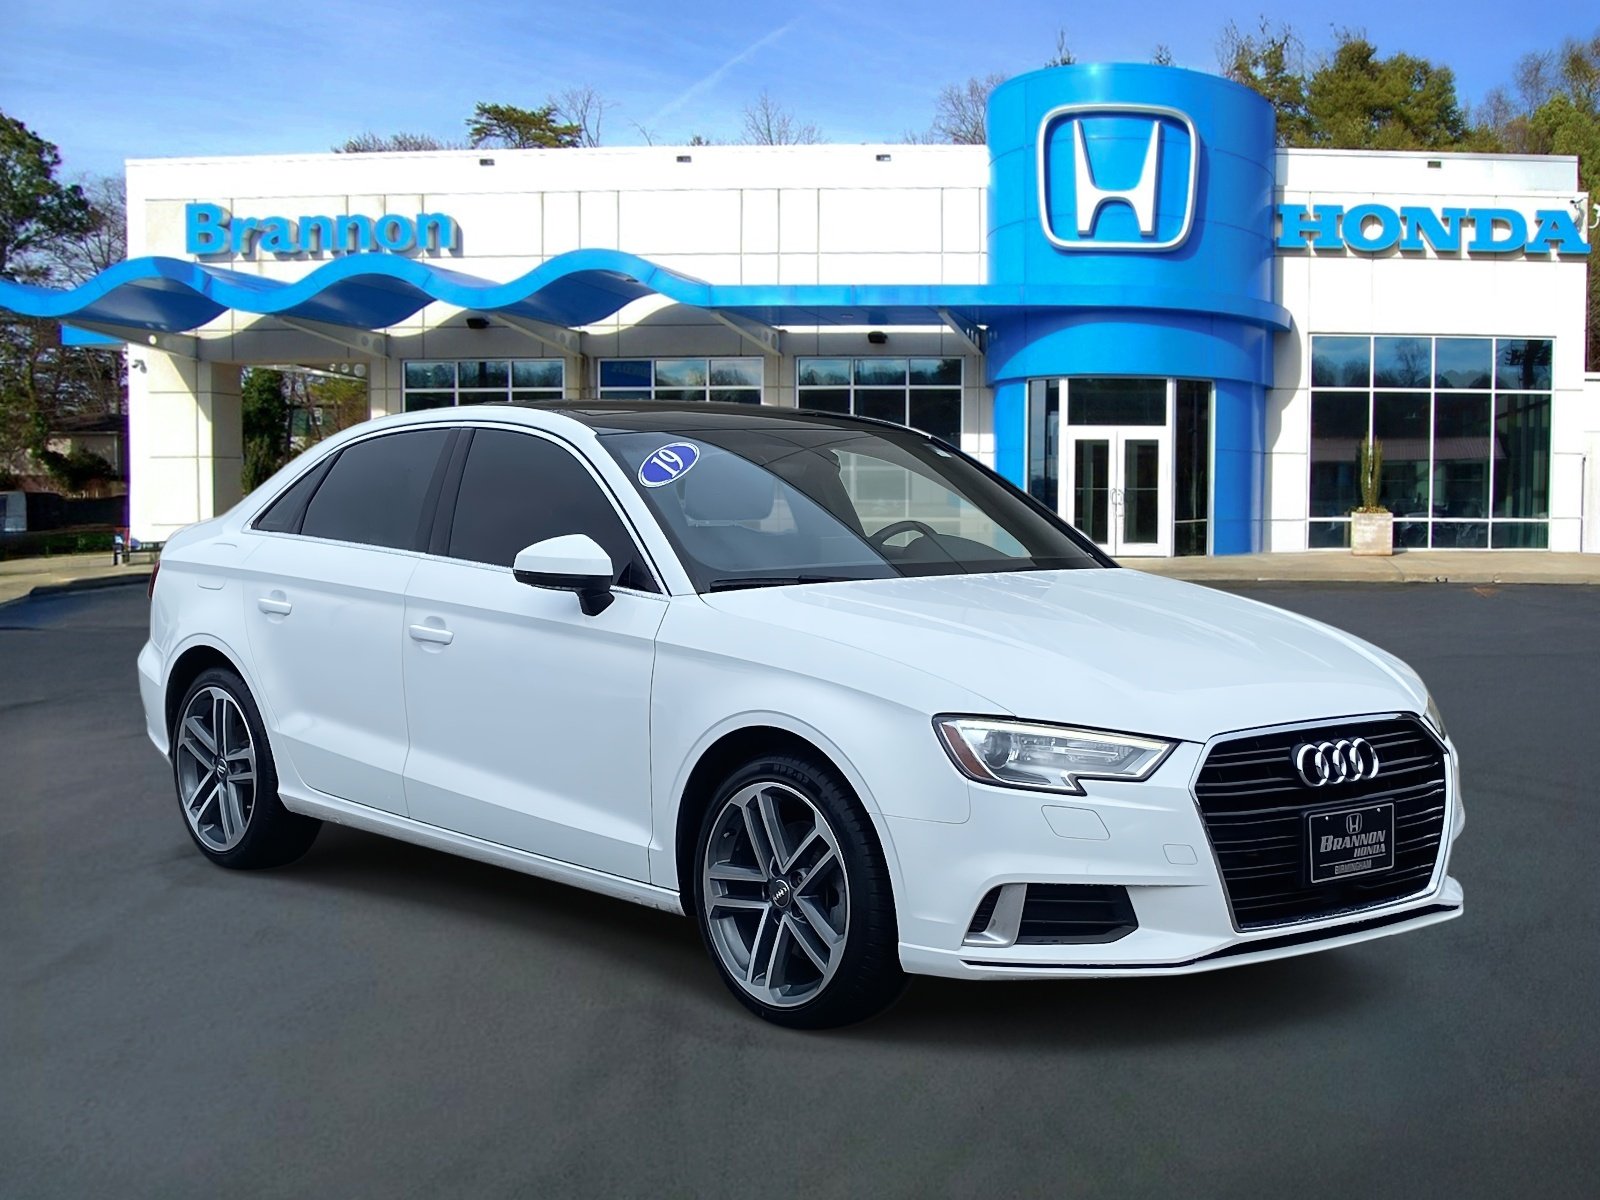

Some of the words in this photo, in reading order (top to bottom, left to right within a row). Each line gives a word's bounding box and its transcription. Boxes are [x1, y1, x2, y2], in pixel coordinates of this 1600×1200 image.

[185, 202, 457, 255] Brannon
[1276, 203, 1592, 256] HONDA
[650, 448, 684, 479] 19
[1320, 830, 1386, 852] BRANNON
[1353, 843, 1386, 857] HONDA
[1335, 860, 1372, 874] BIRMINGHAM
